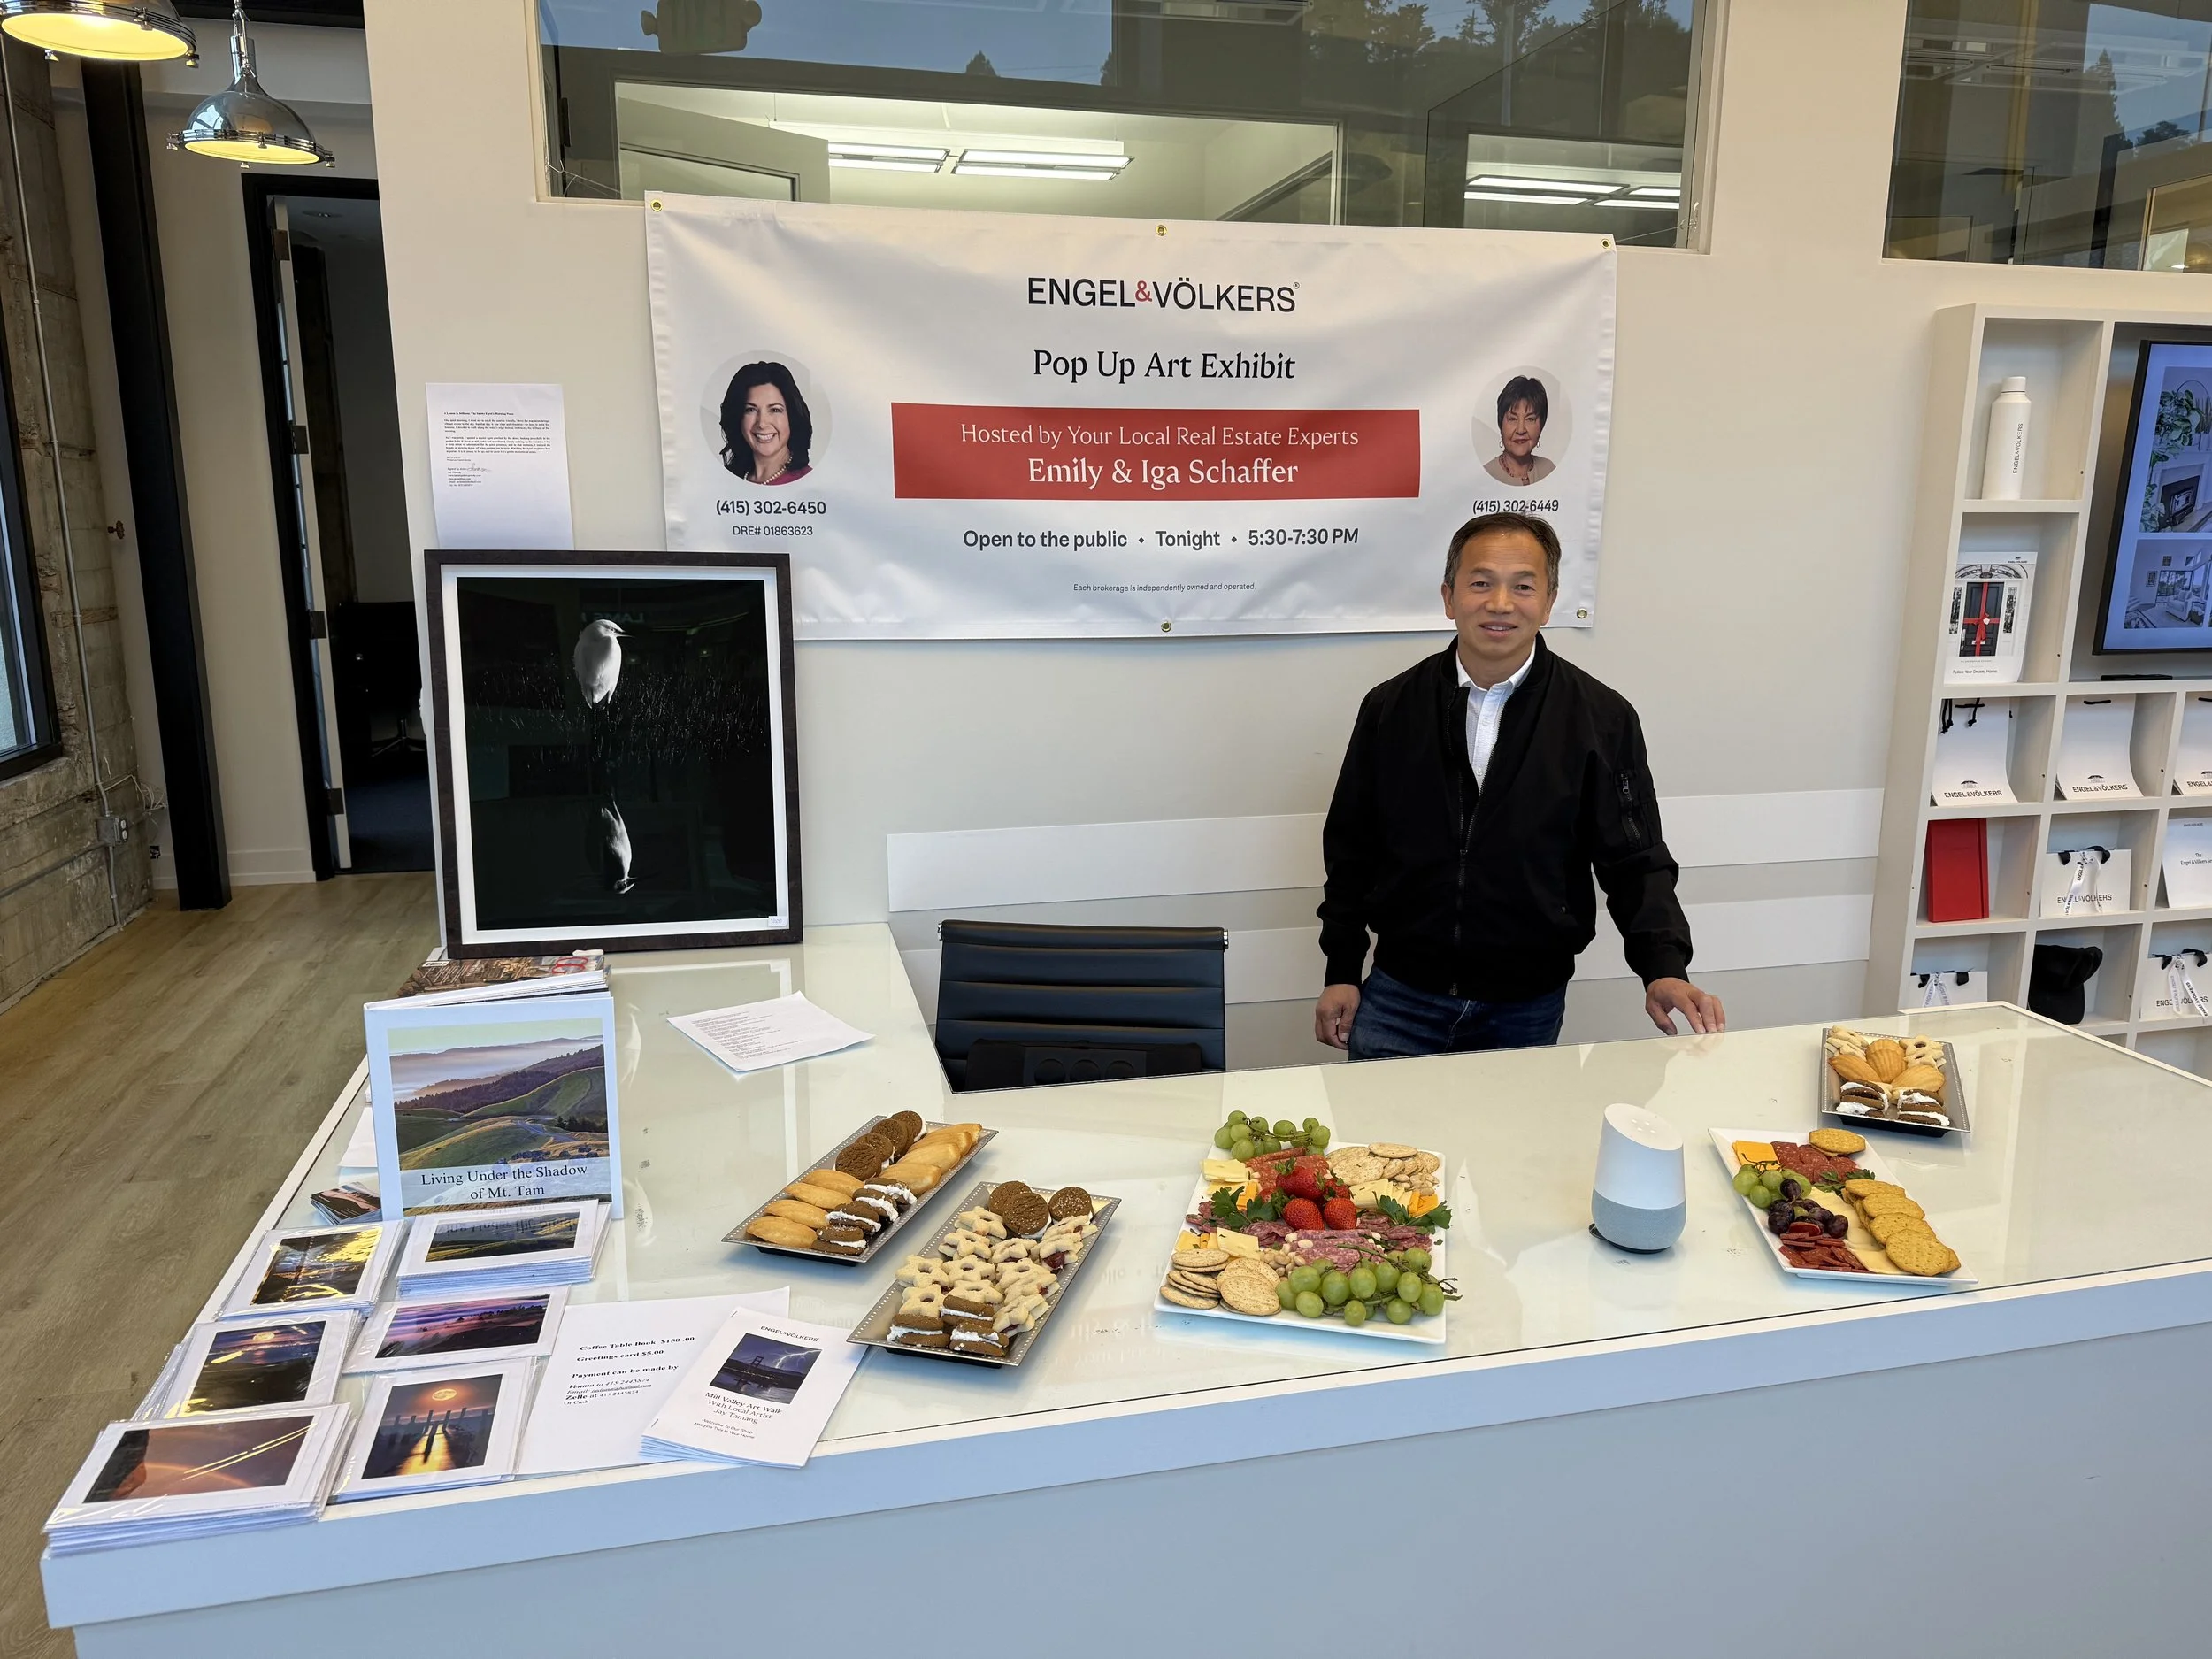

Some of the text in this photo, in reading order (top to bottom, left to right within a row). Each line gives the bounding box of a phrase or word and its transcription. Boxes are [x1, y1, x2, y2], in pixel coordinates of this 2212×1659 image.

[1034, 350, 1295, 384] Pop Up Art Exhibit
[962, 424, 1358, 449] Hosted by Your Local Real Estate Experts
[1029, 457, 1298, 490] Emily & Iga Schaffer
[717, 500, 826, 516] (415) 302-6450
[1473, 499, 1559, 515] (415) 302-6449
[733, 526, 812, 535] DRE# 01863623
[964, 528, 1358, 551] Open to the public Tonight 5:30-7:30 PM
[1093, 584, 1129, 593] brokerage
[421, 1165, 588, 1186] Living Under the Shadow
[470, 1185, 545, 1200] of Mt. Tam
[709, 1400, 772, 1419] With Local Artist
[723, 1396, 746, 1407] Valley
[763, 1406, 782, 1415] Walk
[729, 1412, 758, 1425] Tamang
